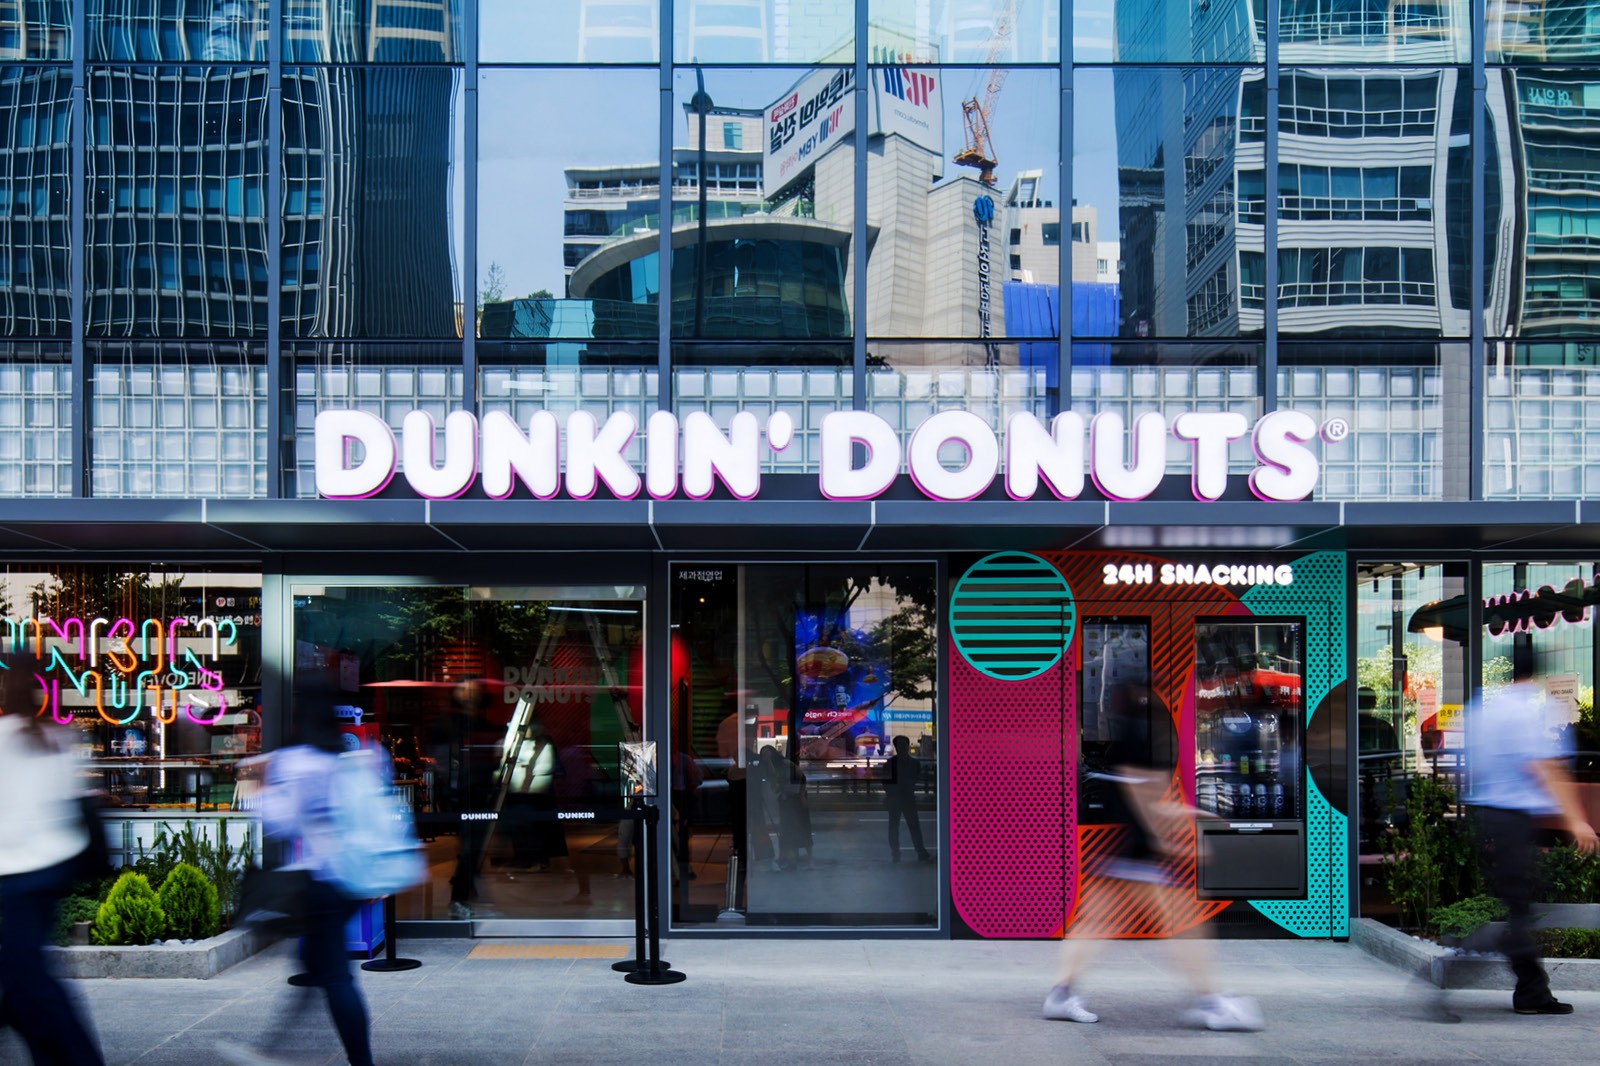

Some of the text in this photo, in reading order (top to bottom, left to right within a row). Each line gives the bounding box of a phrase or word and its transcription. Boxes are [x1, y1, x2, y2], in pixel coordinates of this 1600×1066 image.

[315, 409, 793, 500] DUNKIN'
[1103, 563, 1294, 586] 24H SNACKING
[461, 812, 498, 821] DUNKIN
[558, 811, 595, 820] DUNKIN
